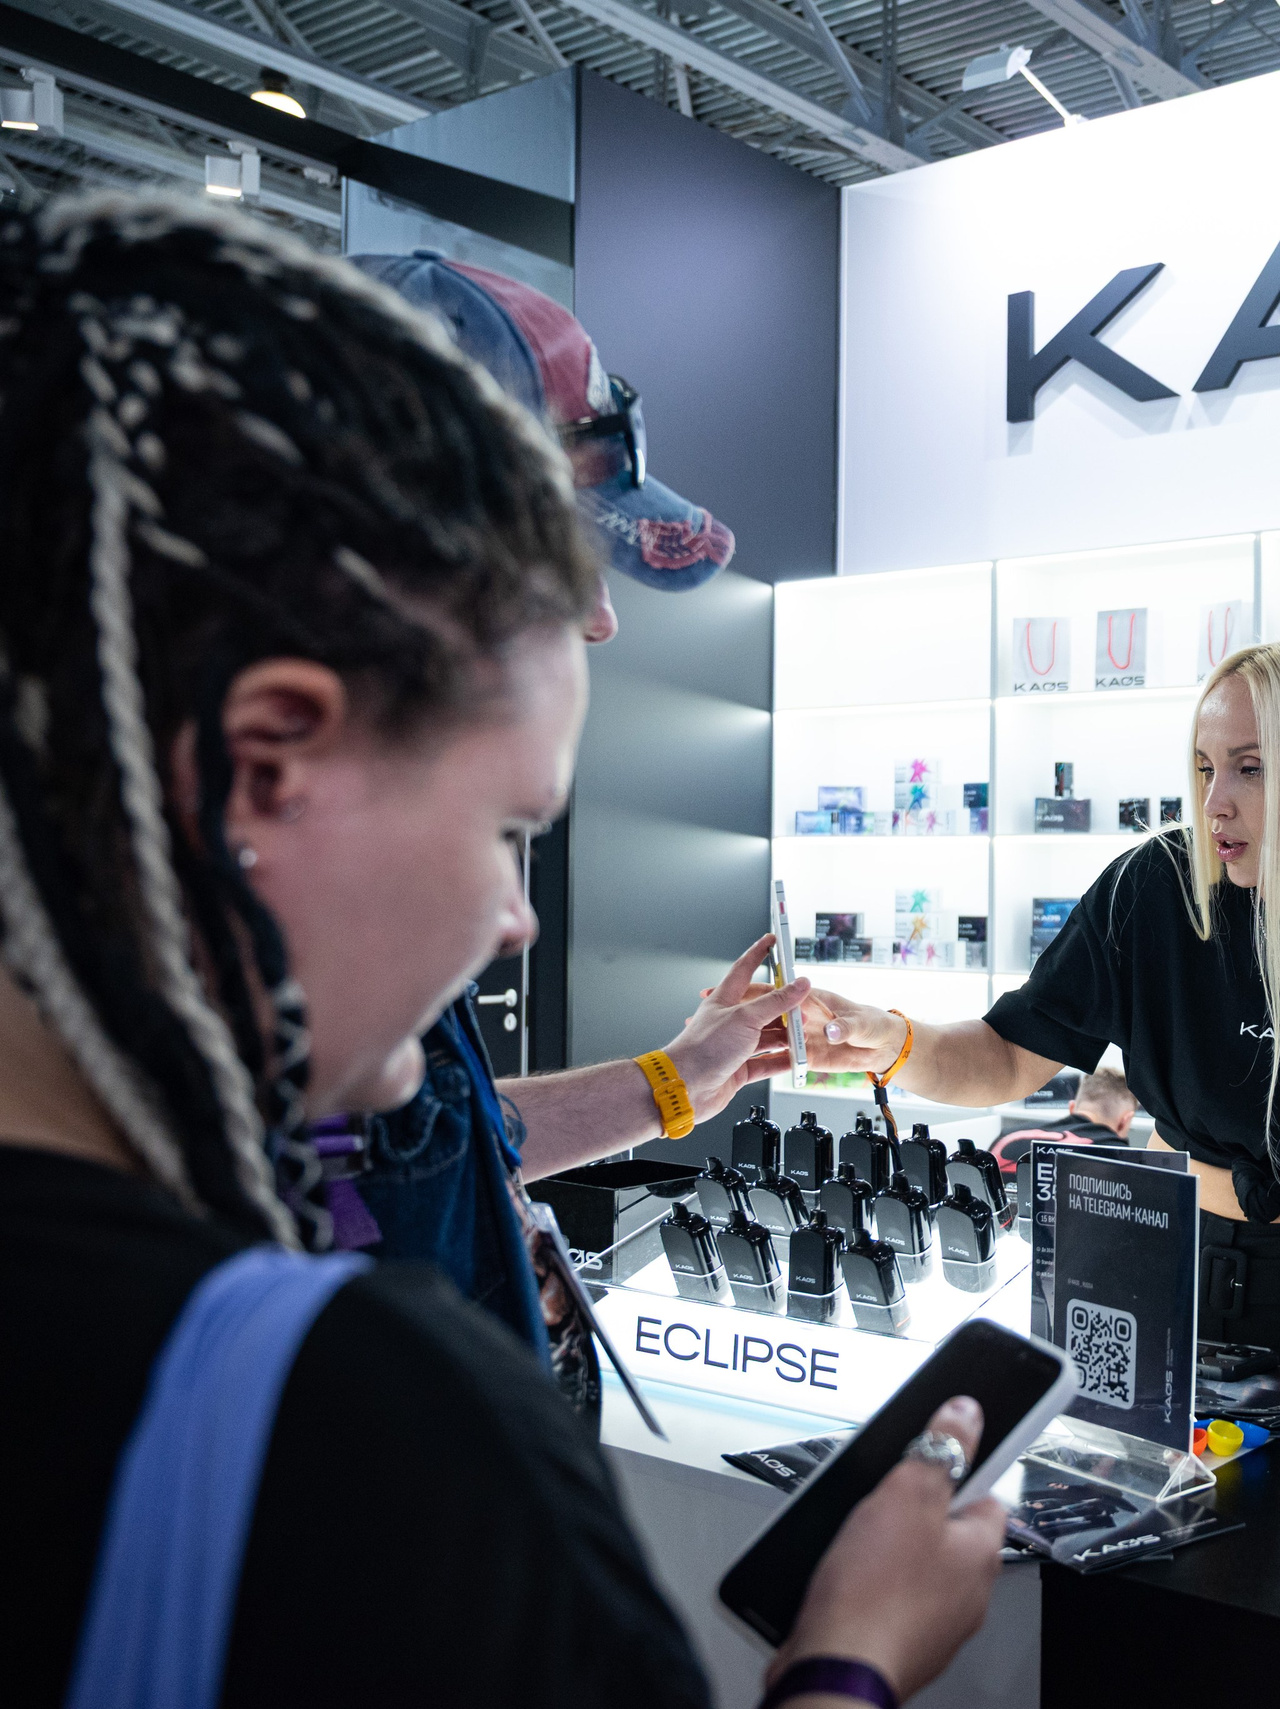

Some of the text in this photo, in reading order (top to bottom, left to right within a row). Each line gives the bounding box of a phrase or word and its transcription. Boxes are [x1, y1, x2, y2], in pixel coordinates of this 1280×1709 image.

[1069, 1173, 1132, 1201] ПОДПИШИСЬ
[1069, 1193, 1082, 1211] НА
[636, 1316, 840, 1391] ECLIPSE
